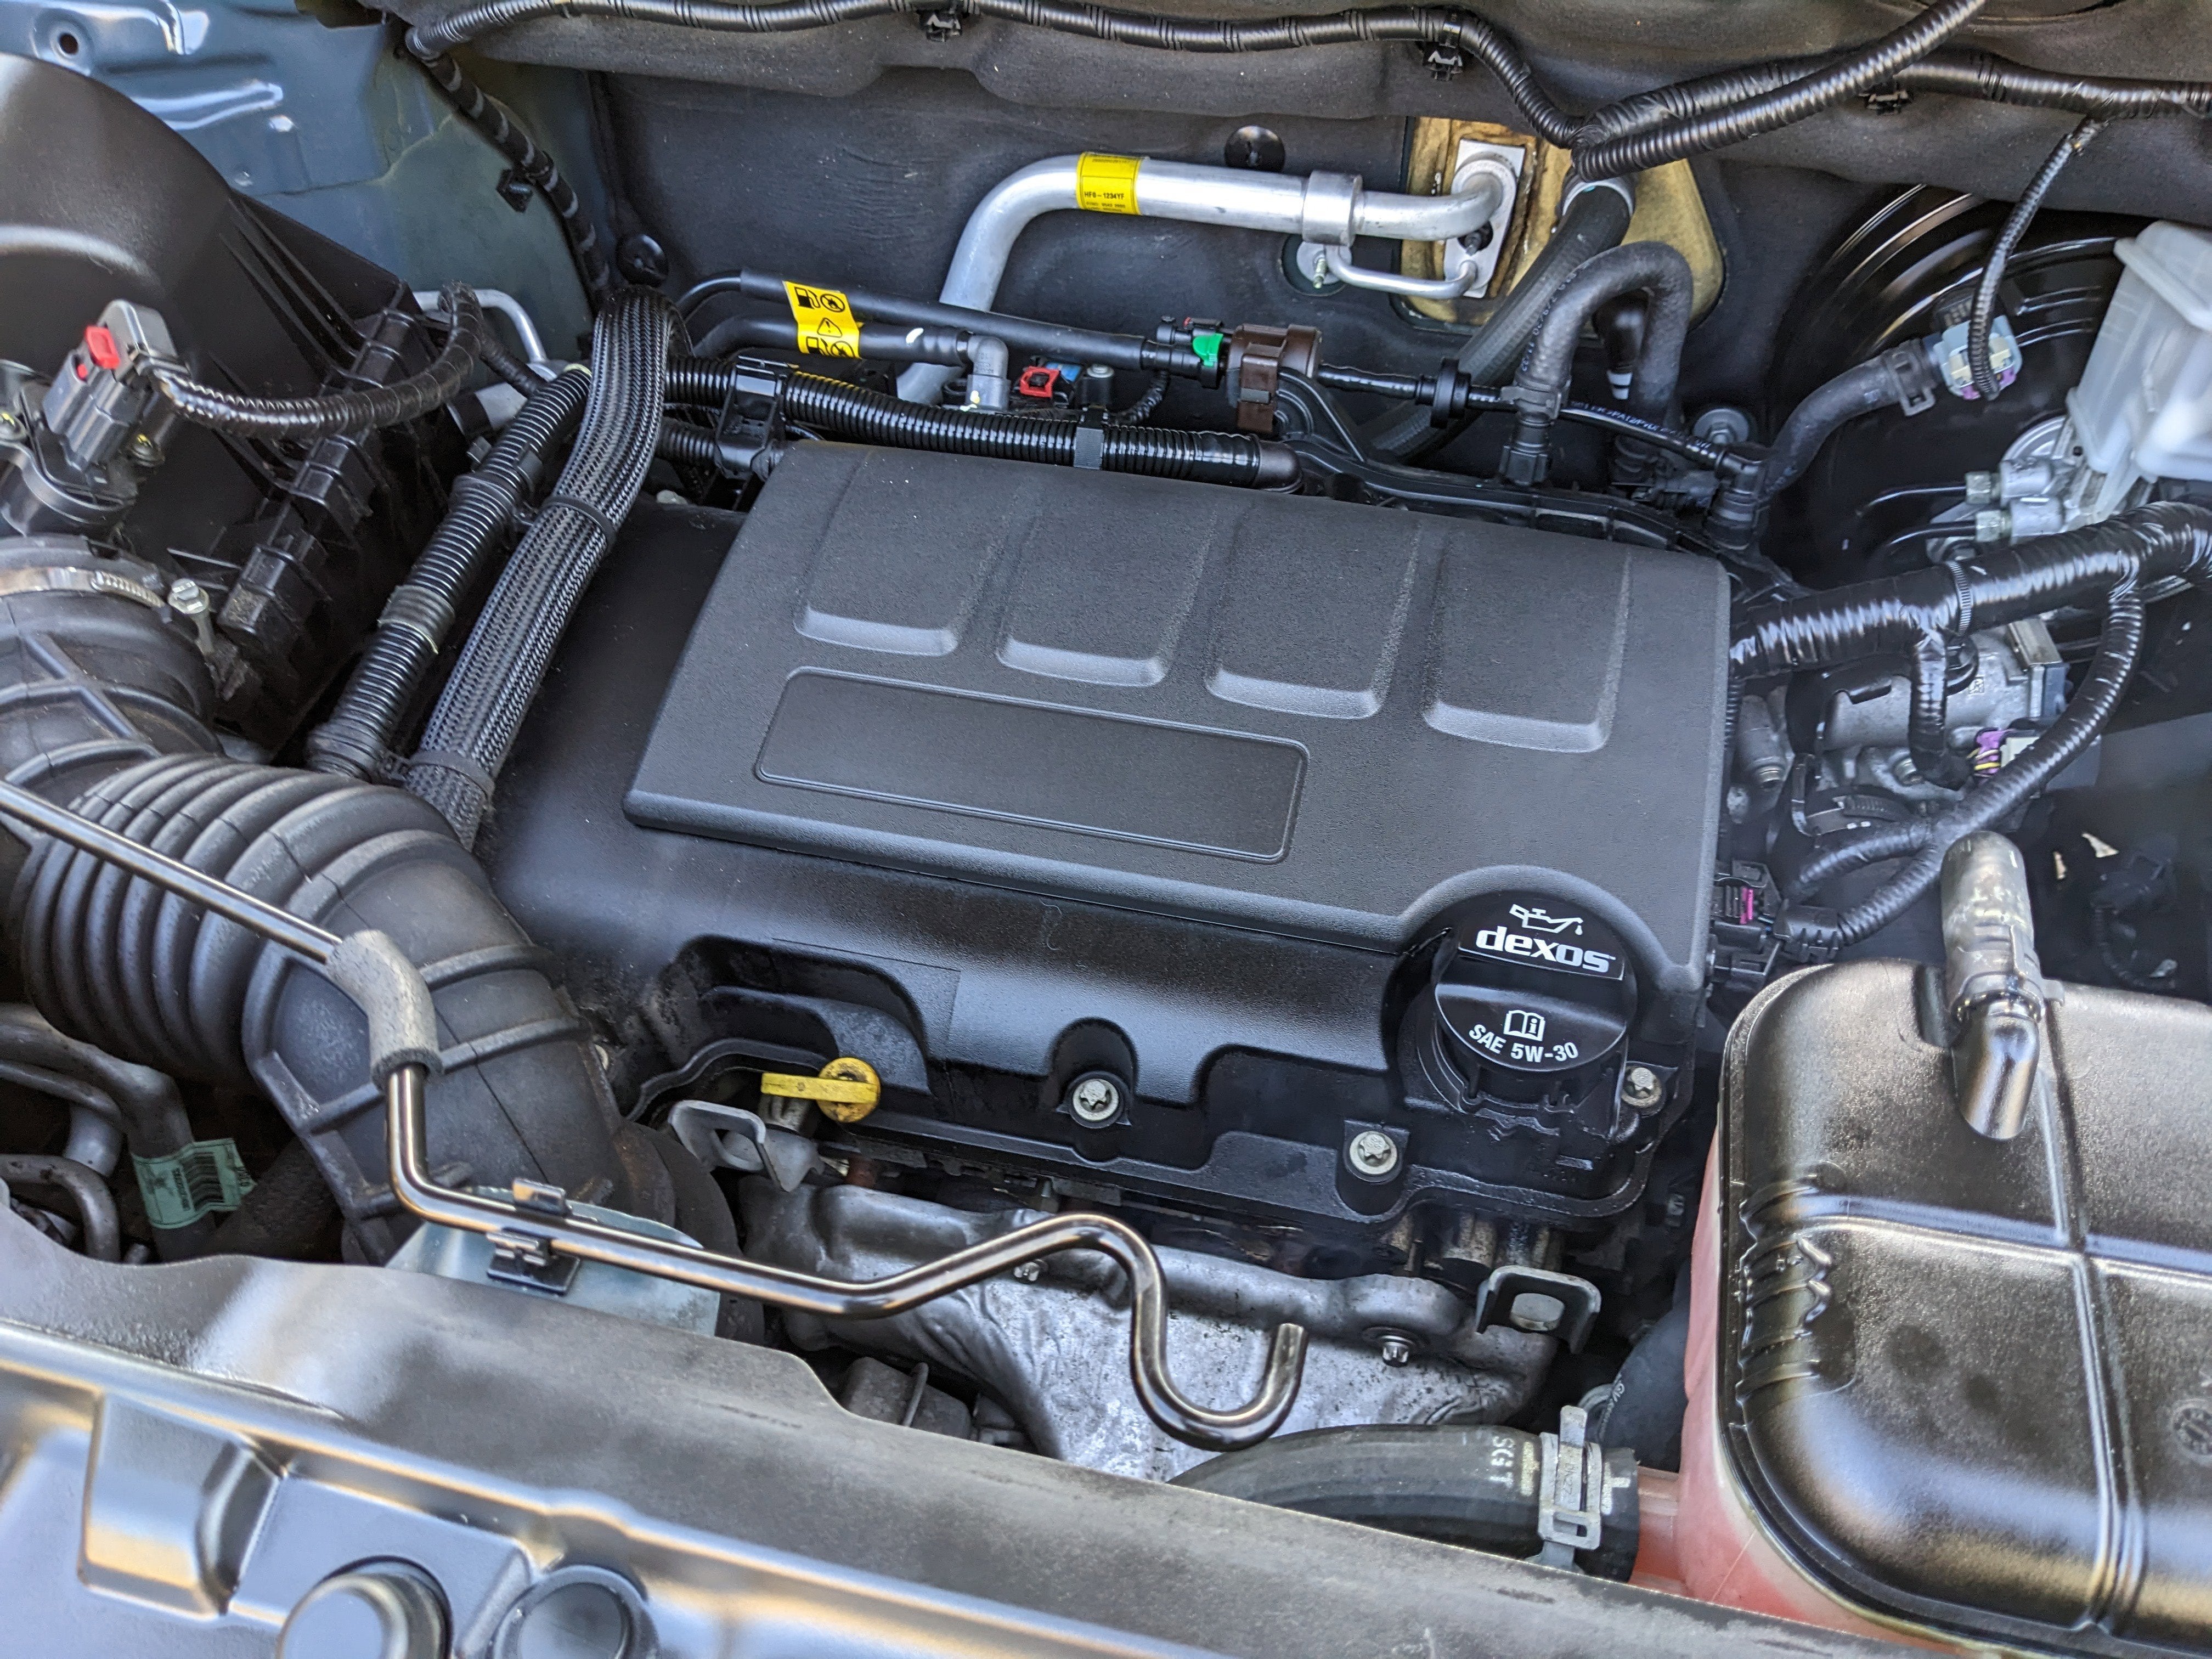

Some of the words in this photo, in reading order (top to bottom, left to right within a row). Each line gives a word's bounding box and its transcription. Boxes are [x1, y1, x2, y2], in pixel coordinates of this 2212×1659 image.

[1476, 926, 1616, 973] dexos
[1469, 1024, 1506, 1054] SAE
[1511, 1042, 1578, 1063] 5W-30
